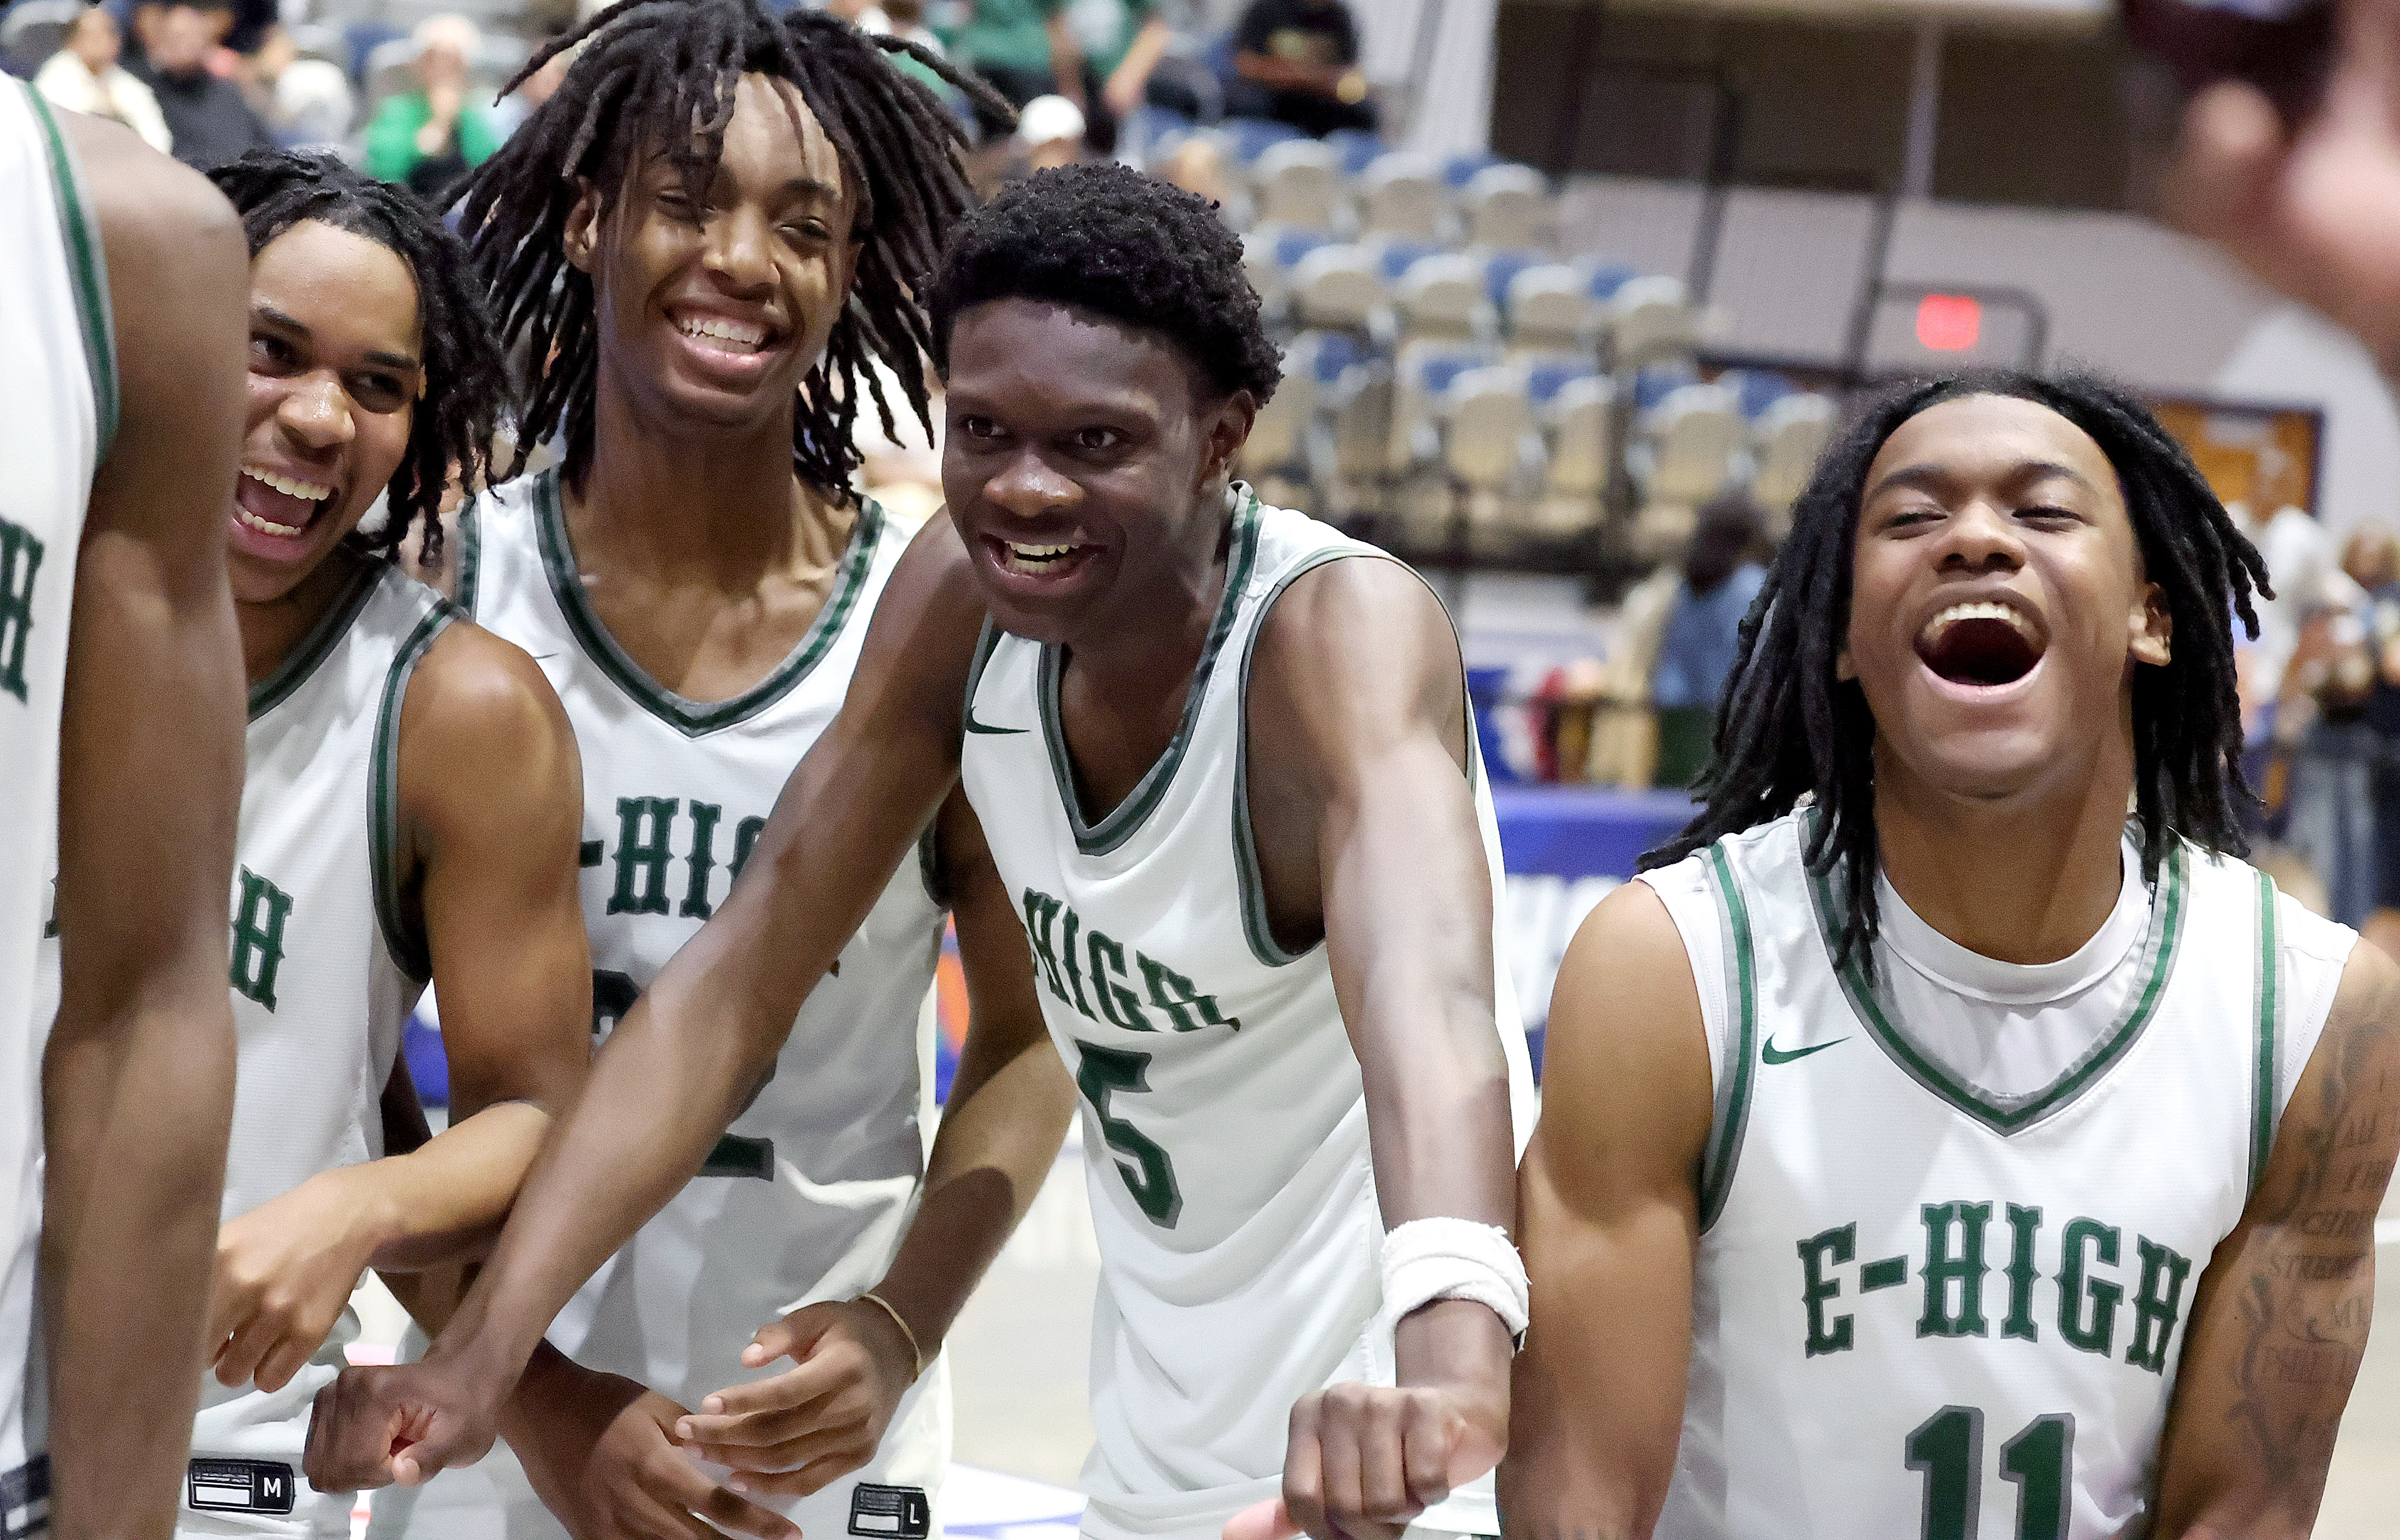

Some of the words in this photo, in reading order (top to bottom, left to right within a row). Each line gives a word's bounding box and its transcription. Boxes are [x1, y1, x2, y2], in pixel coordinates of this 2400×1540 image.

[1074, 1036, 1184, 1230] 5
[1796, 1200, 2192, 1377] E-HIGH
[263, 1477, 282, 1498] M
[909, 1502, 920, 1525] L
[1904, 1405, 2076, 1540] 11
